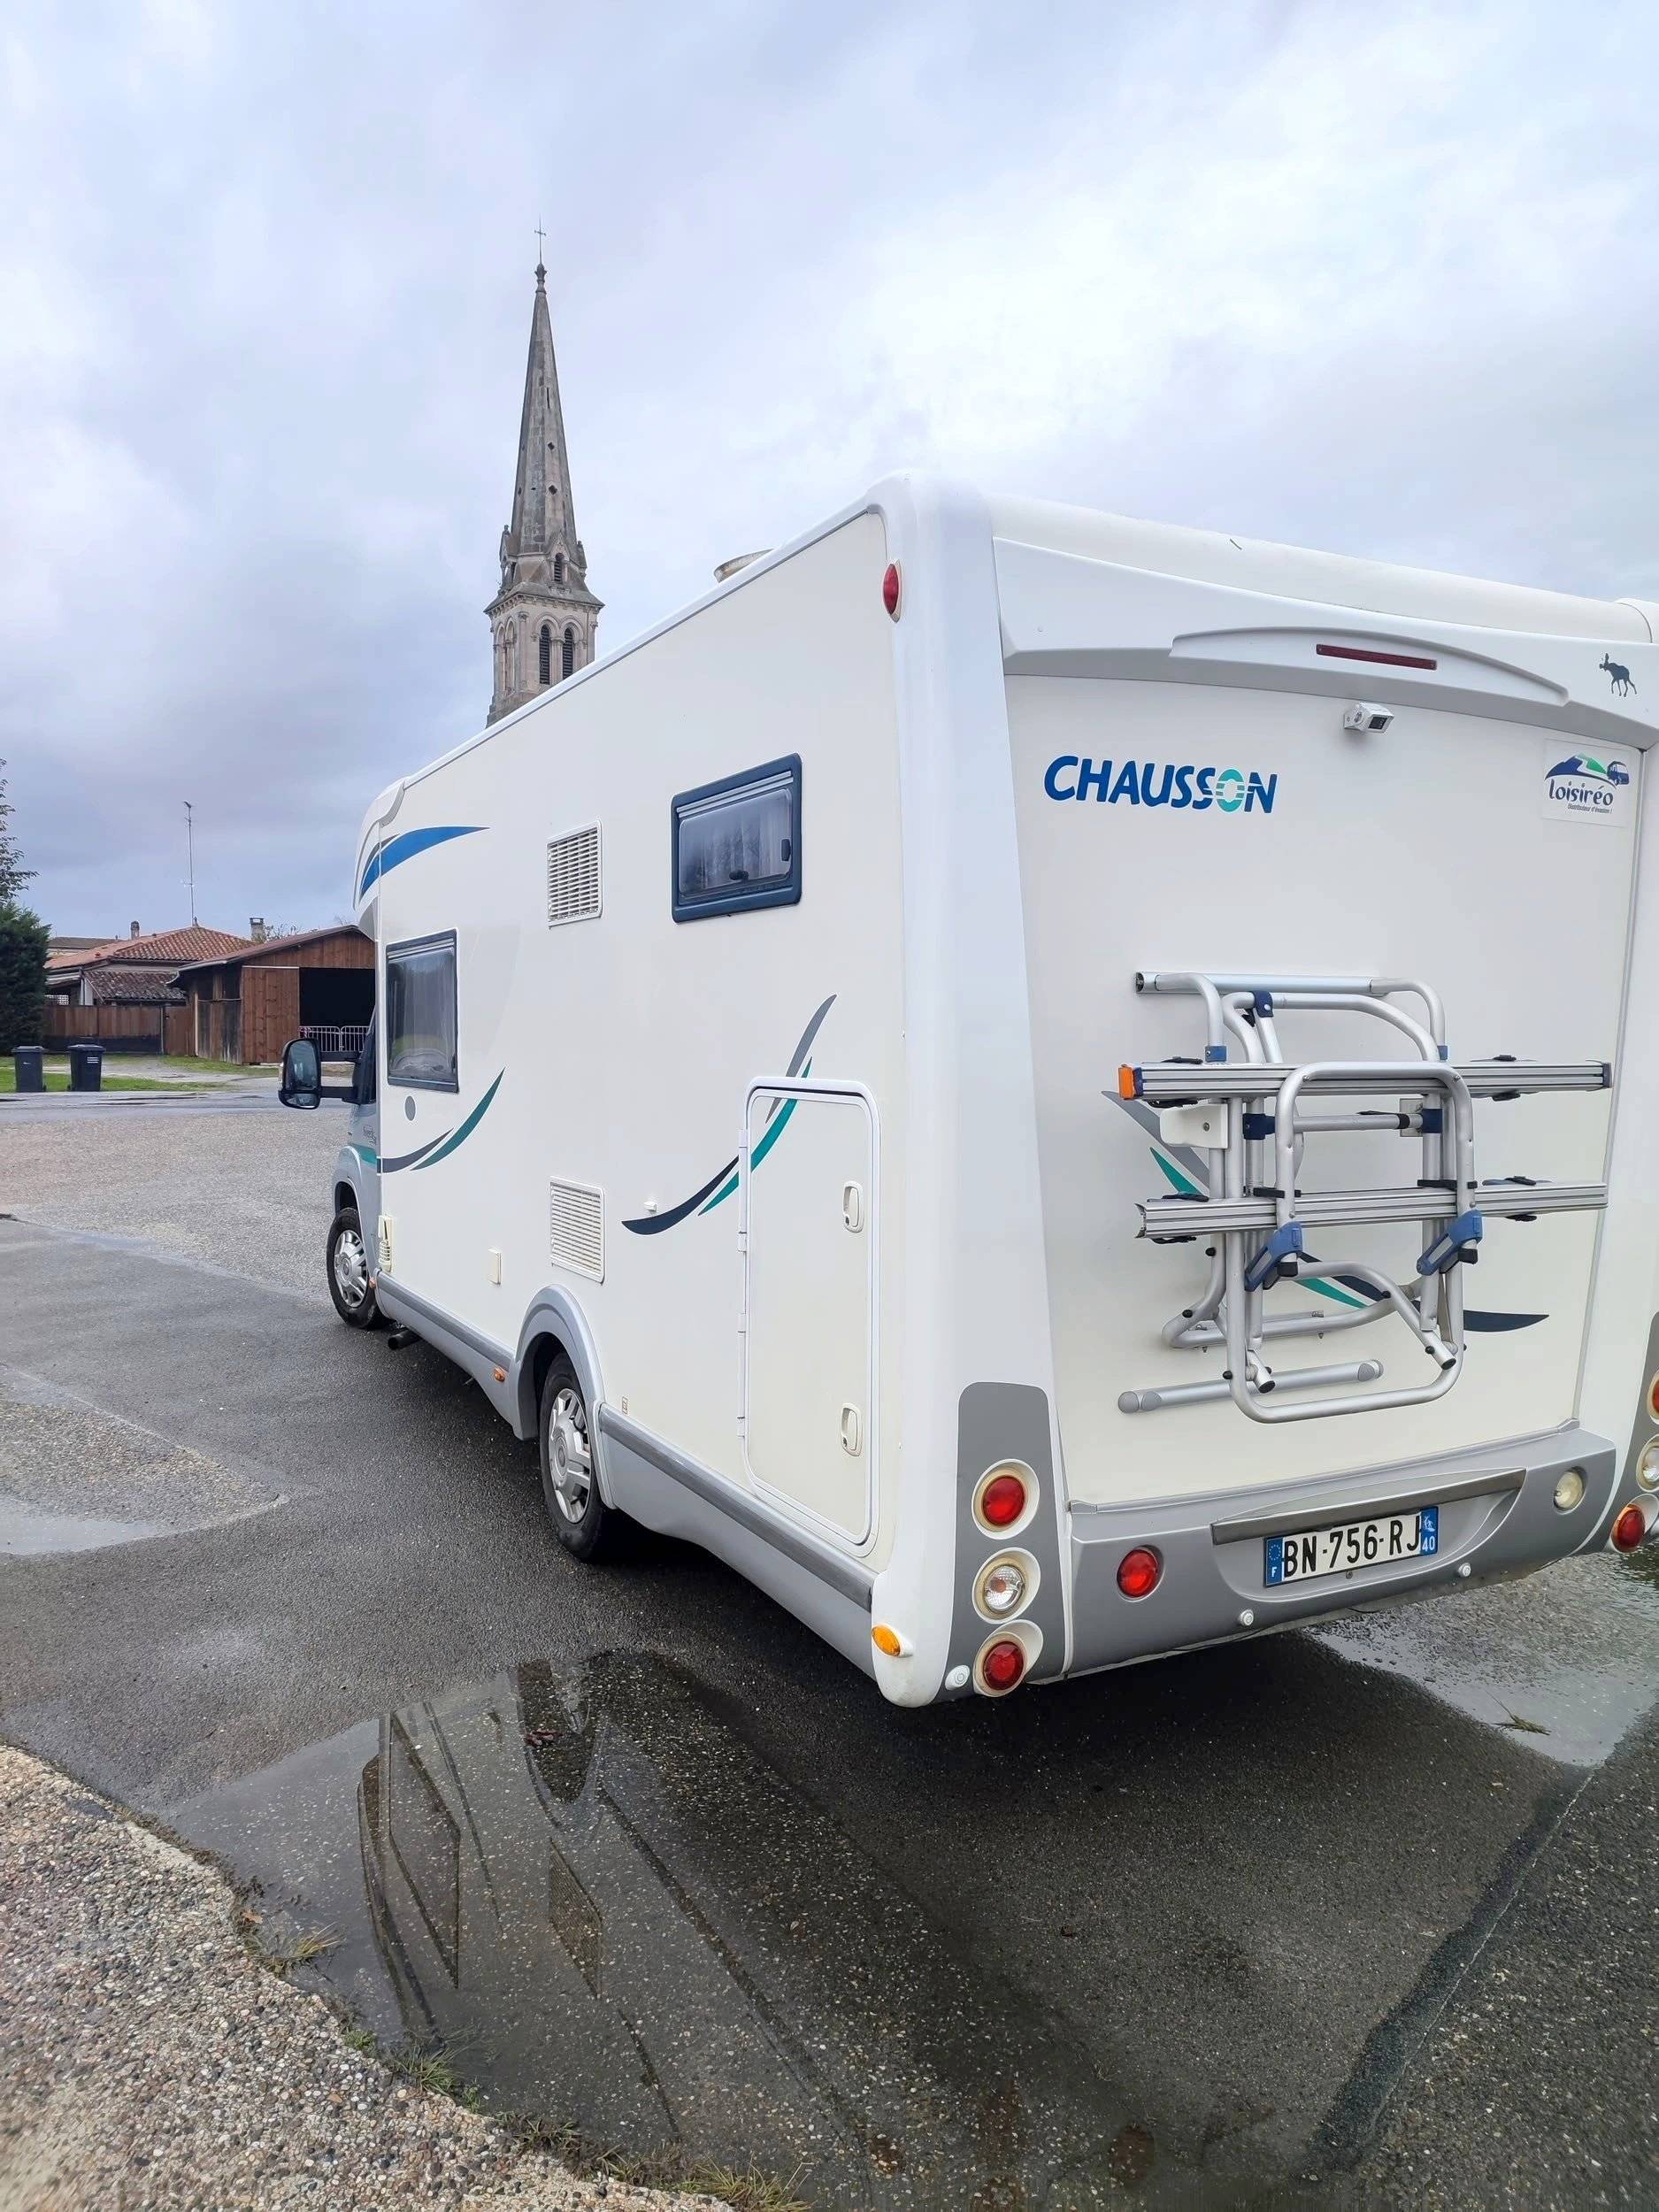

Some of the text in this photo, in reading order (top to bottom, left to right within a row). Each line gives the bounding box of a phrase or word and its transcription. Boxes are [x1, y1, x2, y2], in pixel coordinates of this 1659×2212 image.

[1044, 756, 1278, 813] CHAUSSON
[1271, 1566, 1278, 1578] F
[1422, 1535, 1436, 1552] 40
